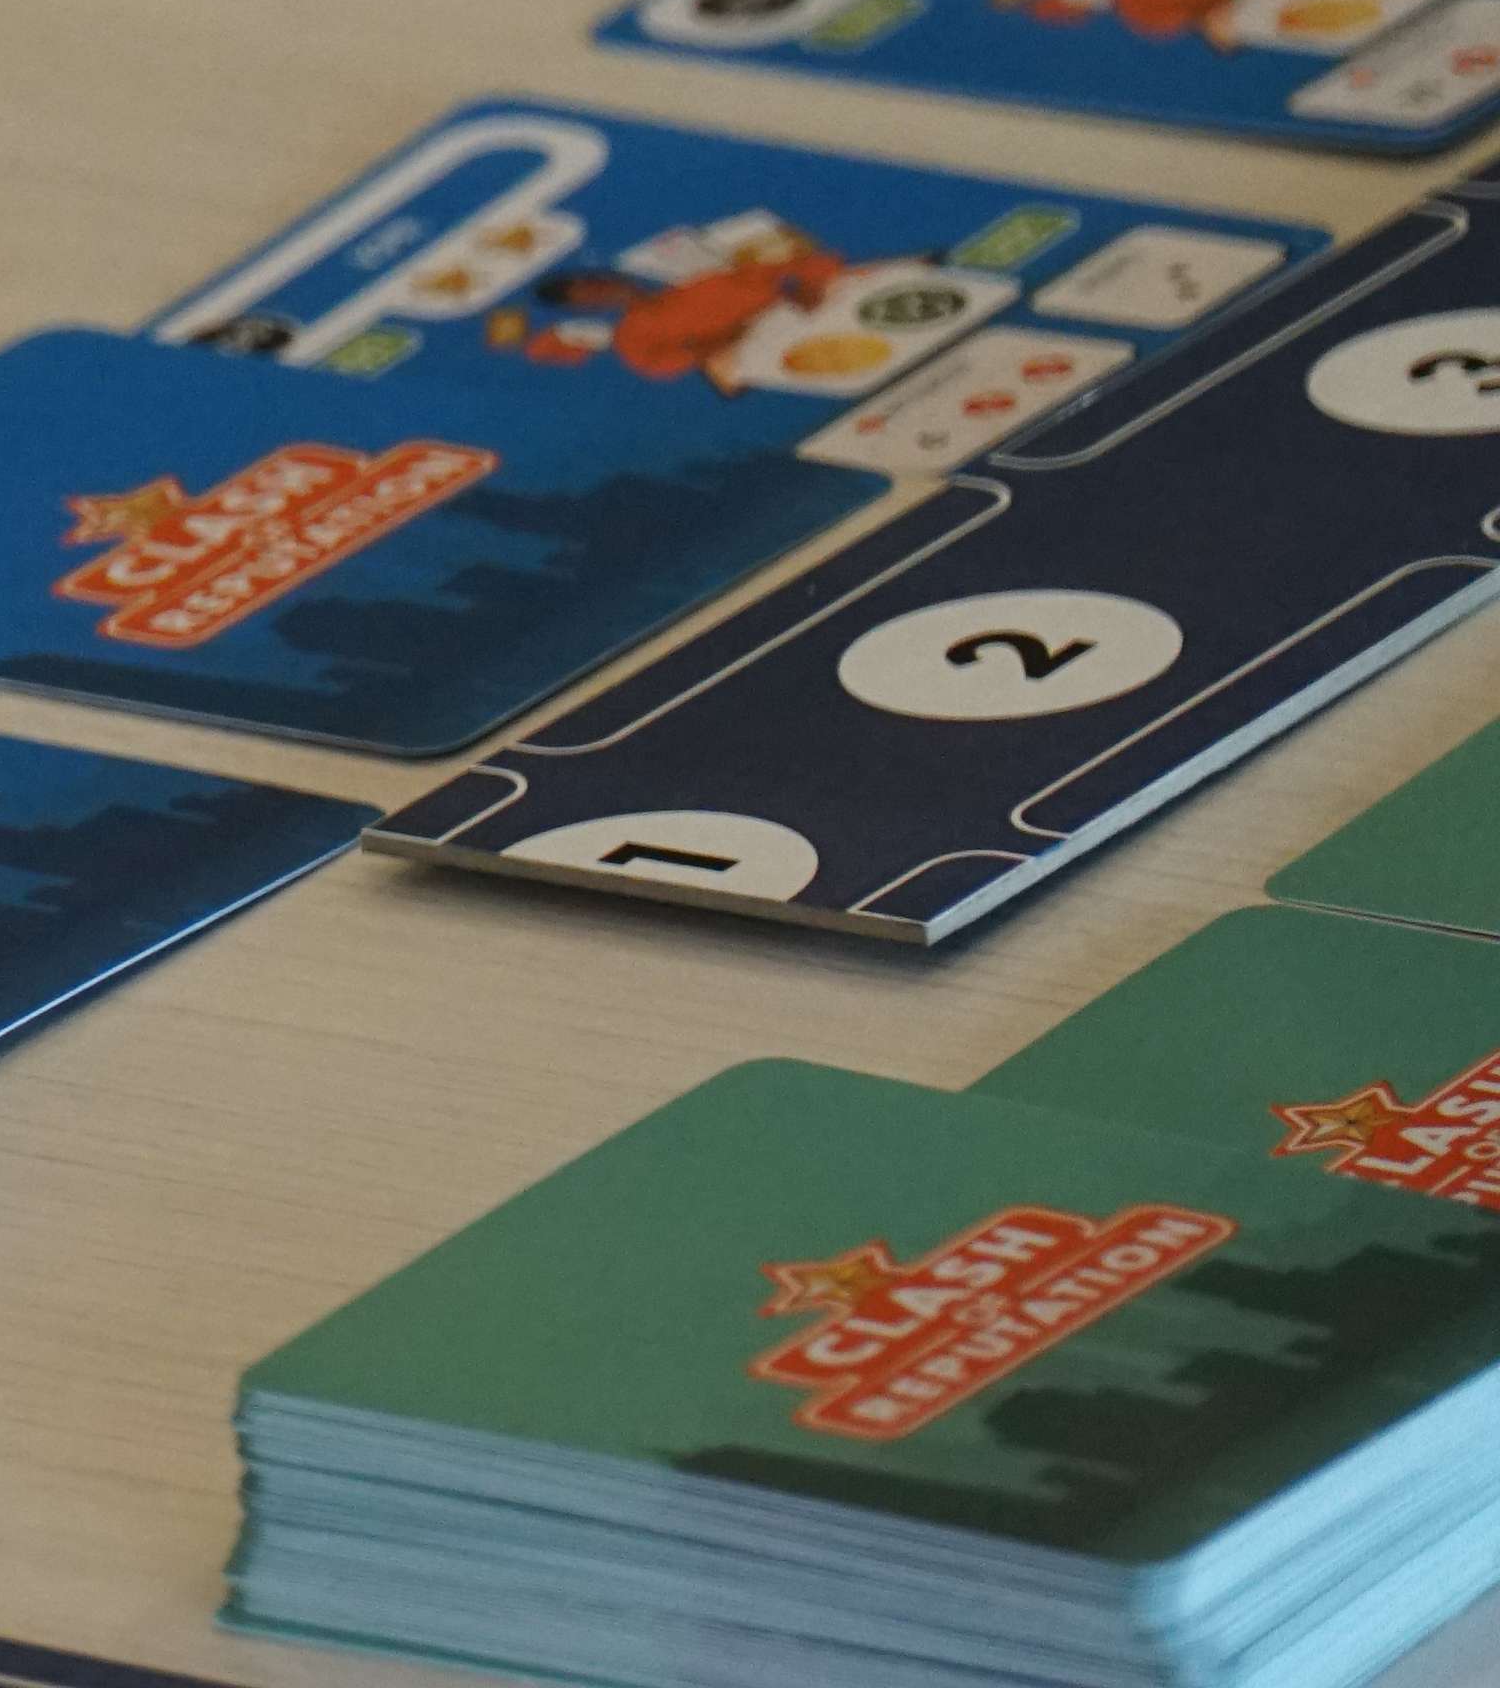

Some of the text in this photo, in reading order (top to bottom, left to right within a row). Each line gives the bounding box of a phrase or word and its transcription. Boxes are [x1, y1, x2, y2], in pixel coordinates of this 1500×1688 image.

[944, 628, 1099, 682] 2
[597, 840, 740, 872] 1
[804, 1224, 1060, 1366] CLASH
[850, 1217, 1208, 1421] REPUTATION
